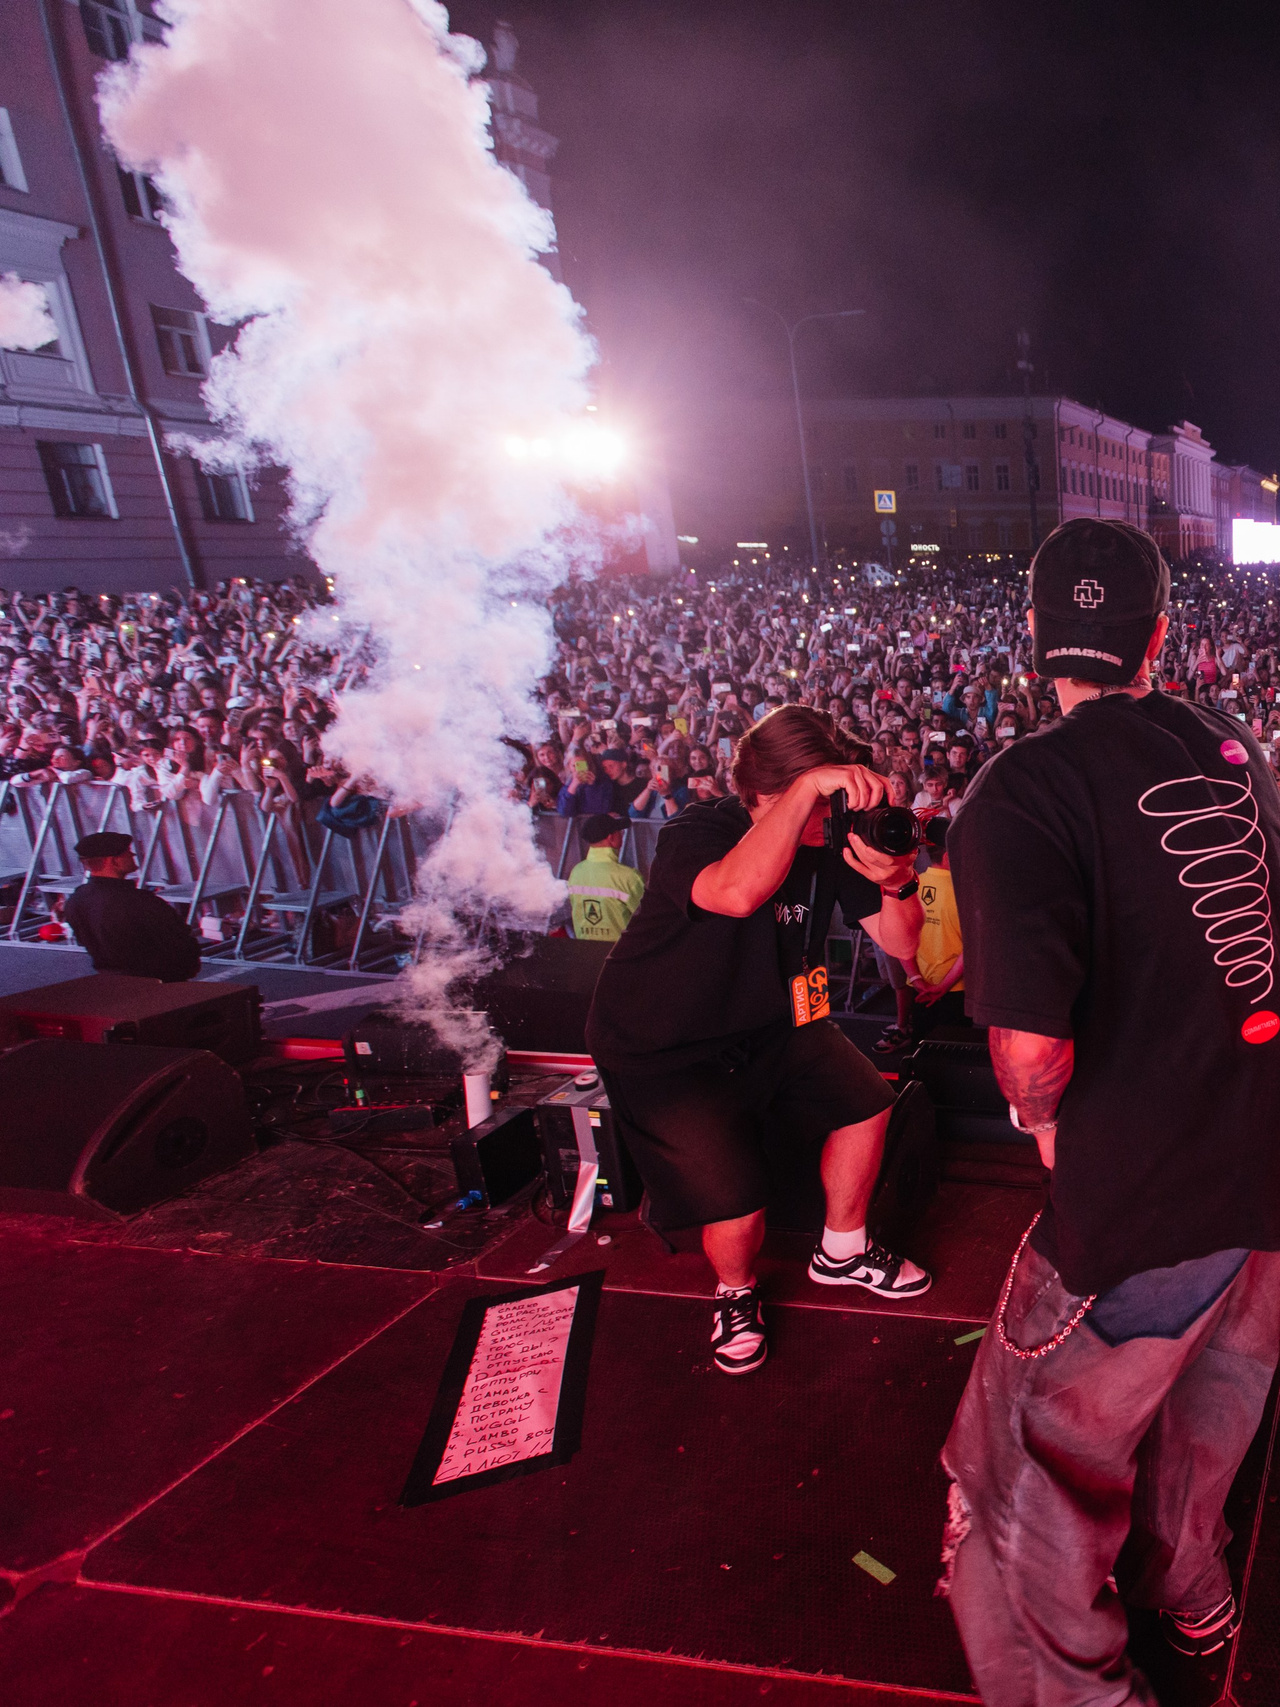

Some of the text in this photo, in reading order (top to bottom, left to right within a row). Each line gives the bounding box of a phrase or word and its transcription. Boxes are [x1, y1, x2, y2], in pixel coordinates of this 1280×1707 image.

[794, 981, 807, 1022] АРТИСТ
[486, 1351, 513, 1361] ГДЕ
[489, 1340, 524, 1353] ГОЛОС
[487, 1349, 554, 1370] ОТПУСКАЮ
[470, 1369, 542, 1394] ПОППУРРИ
[470, 1392, 531, 1414] ДЕВОЧКА
[473, 1386, 520, 1402] САМАЯ
[470, 1399, 535, 1425] ПОТРАЧУ
[463, 1438, 518, 1458] PUSSY
[524, 1427, 555, 1443] BOY
[466, 1427, 519, 1446] LAMBO
[435, 1450, 521, 1481] САЛЮТ
